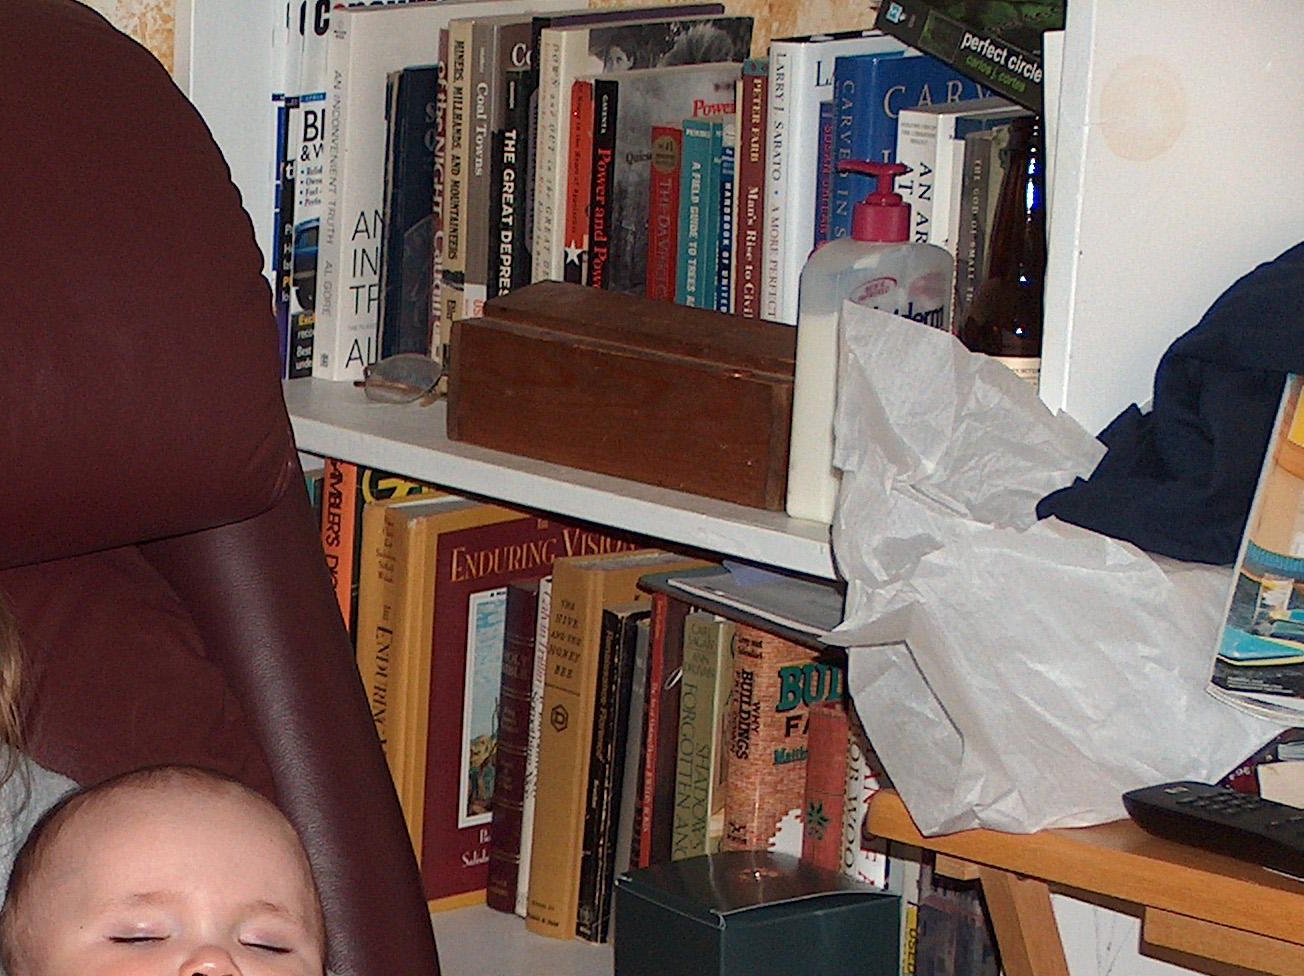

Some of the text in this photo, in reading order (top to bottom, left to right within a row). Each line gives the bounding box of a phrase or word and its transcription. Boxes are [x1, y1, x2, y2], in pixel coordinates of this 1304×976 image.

[774, 53, 787, 101] LARRY
[961, 32, 1043, 84] perfect circle
[476, 82, 489, 119] Coal
[751, 79, 763, 125] PETER
[328, 95, 342, 193] INCONVENIENT
[451, 154, 462, 176] AND
[474, 125, 487, 176] Towns
[503, 129, 517, 164] THE
[771, 121, 784, 181] SABATO
[501, 166, 516, 226] GREAT
[596, 148, 612, 205] Power
[918, 162, 934, 202] AN
[325, 201, 336, 245] TRUTH
[594, 208, 608, 241] and
[722, 182, 732, 246] HANDBOOK
[836, 191, 849, 215] IN
[745, 230, 757, 261] Rise
[769, 214, 780, 254] MORE
[720, 270, 730, 313] UNITED
[767, 260, 778, 319] PERFECT
[451, 538, 558, 583] ENDURING
[554, 613, 580, 630] HIVE
[548, 643, 582, 664] HONEY
[736, 668, 754, 760] BUILDINGS
[751, 702, 761, 734] WHY
[677, 683, 698, 809] FORGOTTEN
